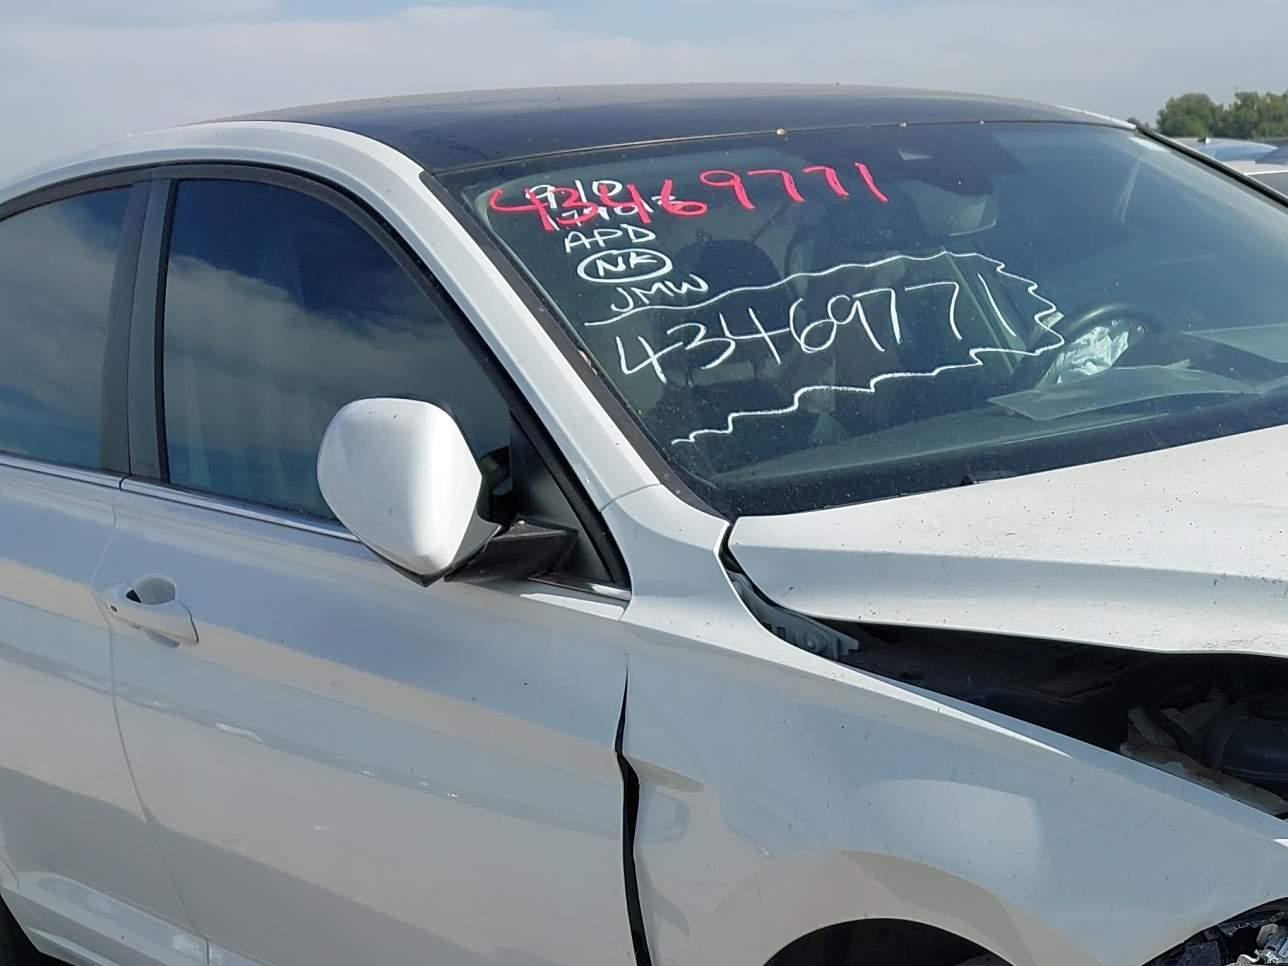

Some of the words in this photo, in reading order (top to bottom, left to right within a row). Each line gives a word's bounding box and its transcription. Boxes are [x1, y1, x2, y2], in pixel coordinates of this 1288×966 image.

[564, 223, 657, 254] APD
[610, 273, 710, 313] JMW
[615, 272, 1018, 384] 43469771
